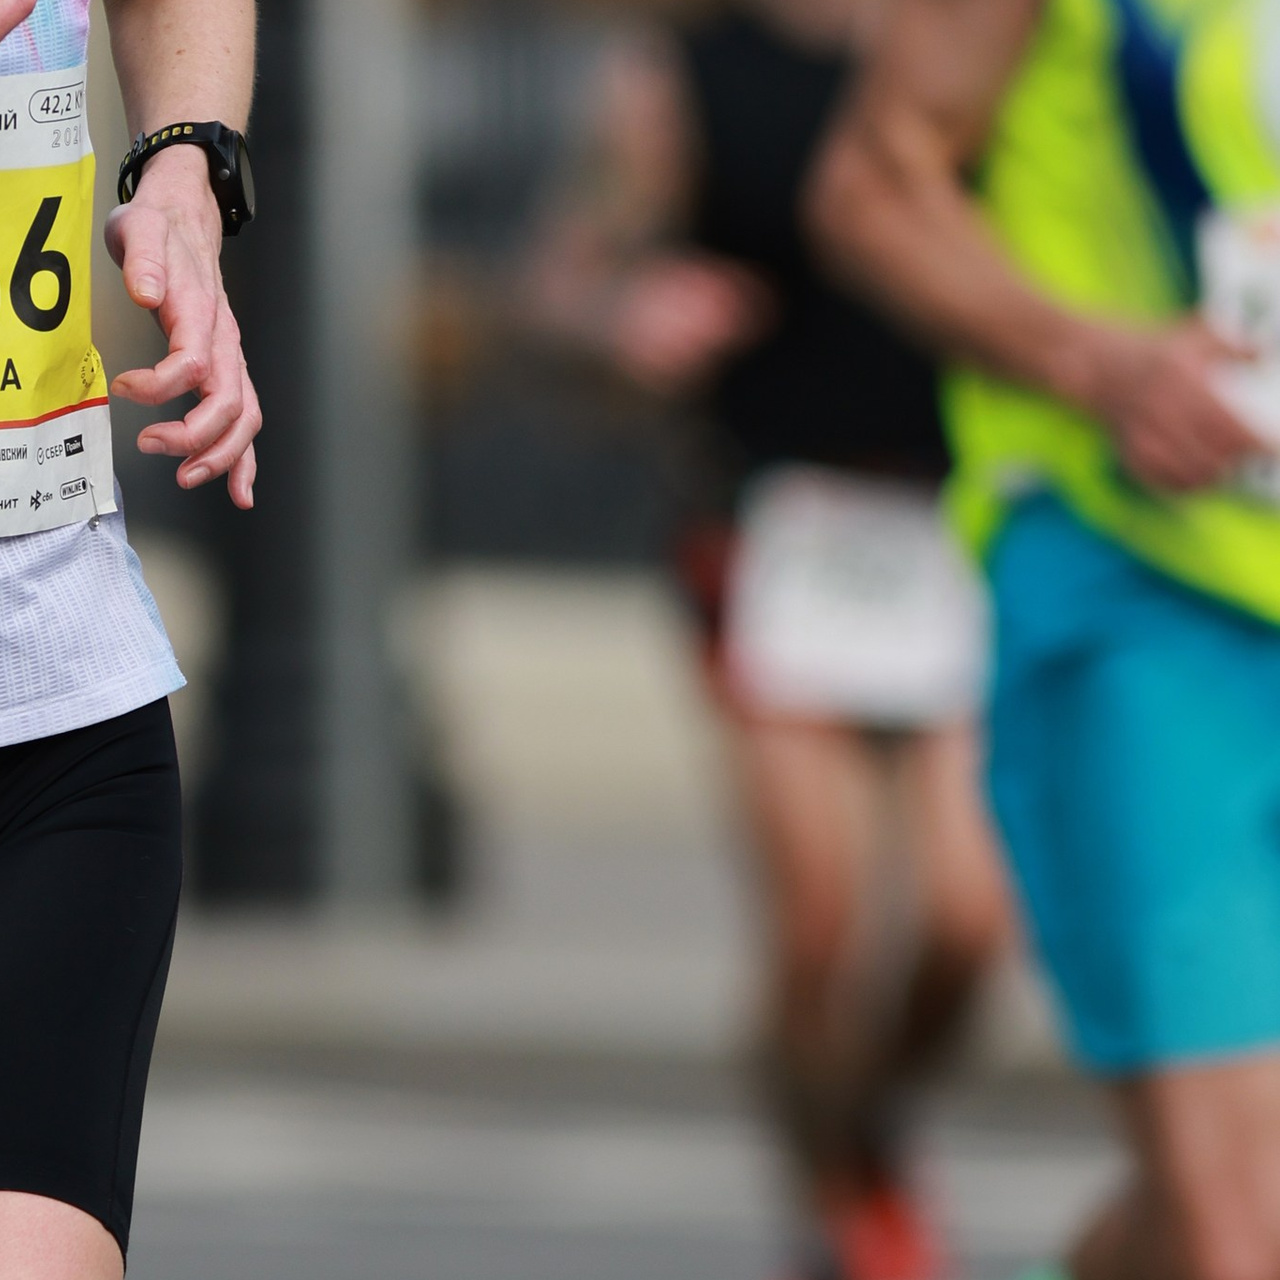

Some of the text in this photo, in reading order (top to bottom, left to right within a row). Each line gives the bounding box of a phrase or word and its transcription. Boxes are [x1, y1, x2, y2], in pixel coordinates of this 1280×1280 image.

[40, 92, 72, 116] 42,2
[51, 124, 82, 149] 202
[45, 444, 64, 460] СБЕР
